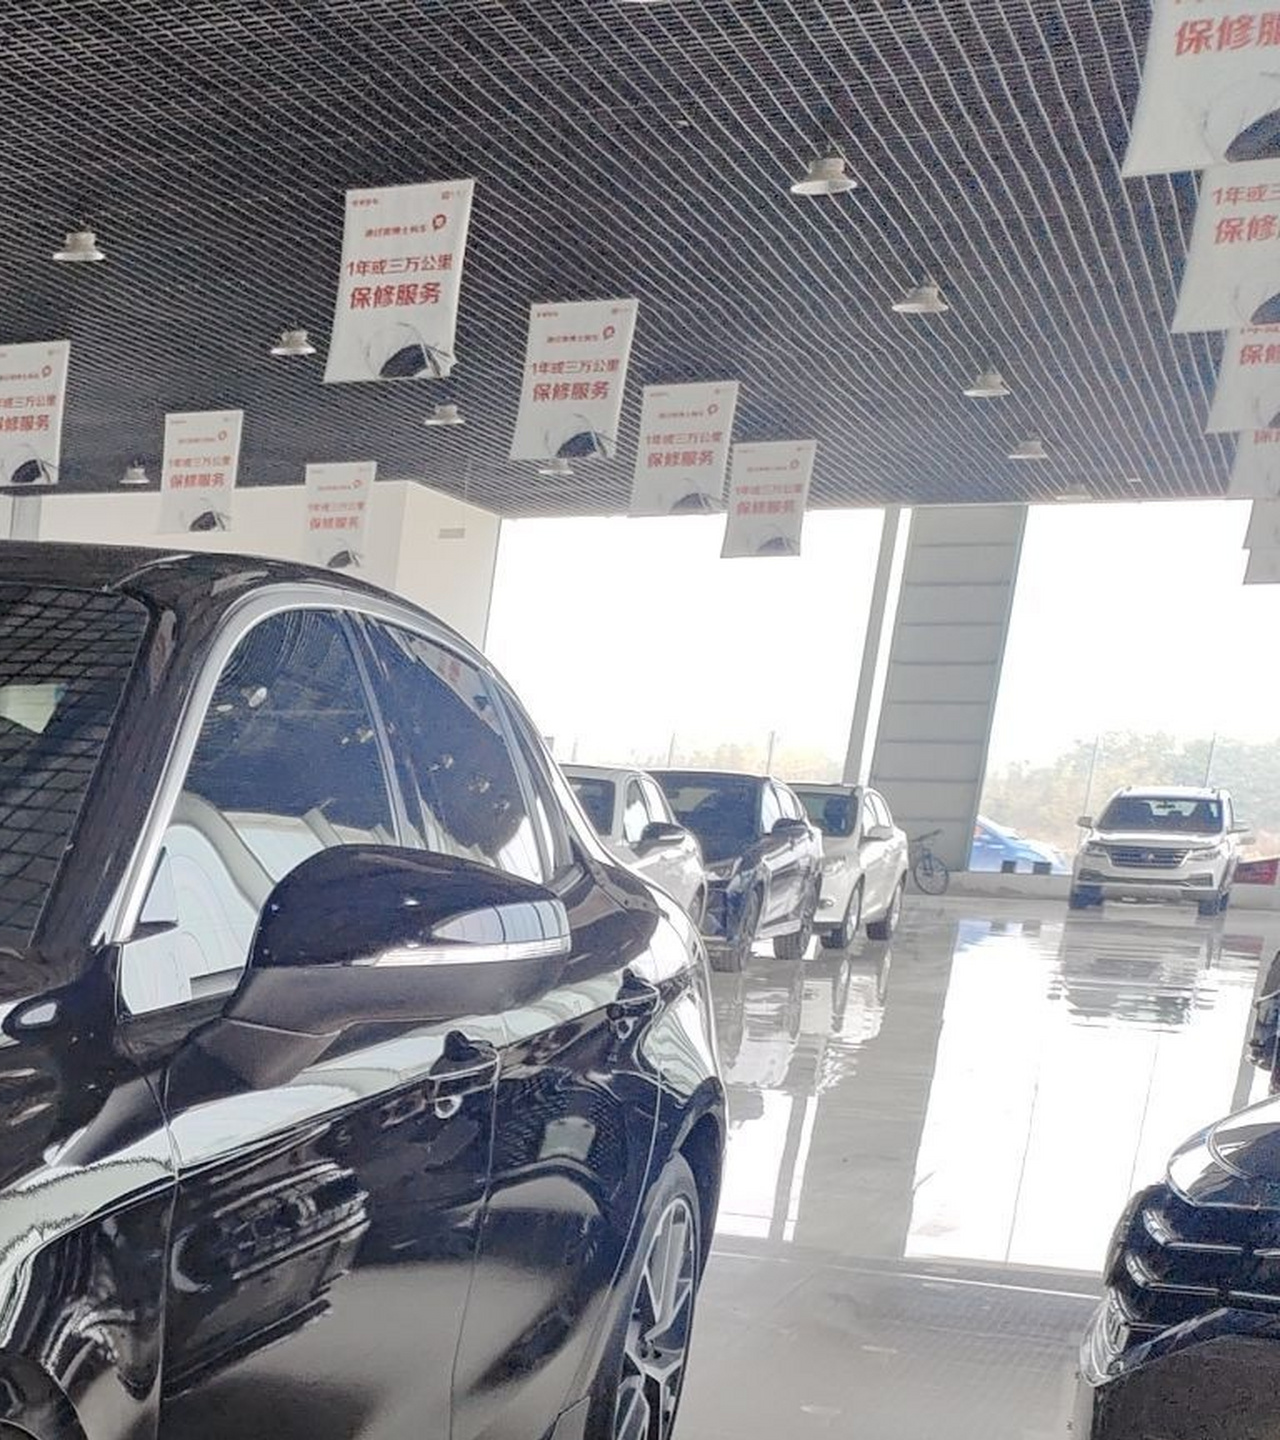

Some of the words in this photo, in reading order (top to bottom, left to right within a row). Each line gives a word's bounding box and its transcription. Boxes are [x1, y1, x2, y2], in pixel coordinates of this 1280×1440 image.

[1215, 214, 1280, 244] 保修
[347, 254, 452, 276] 1年或三万公里
[350, 282, 441, 309] 保修服务
[533, 381, 609, 402] 保修服务
